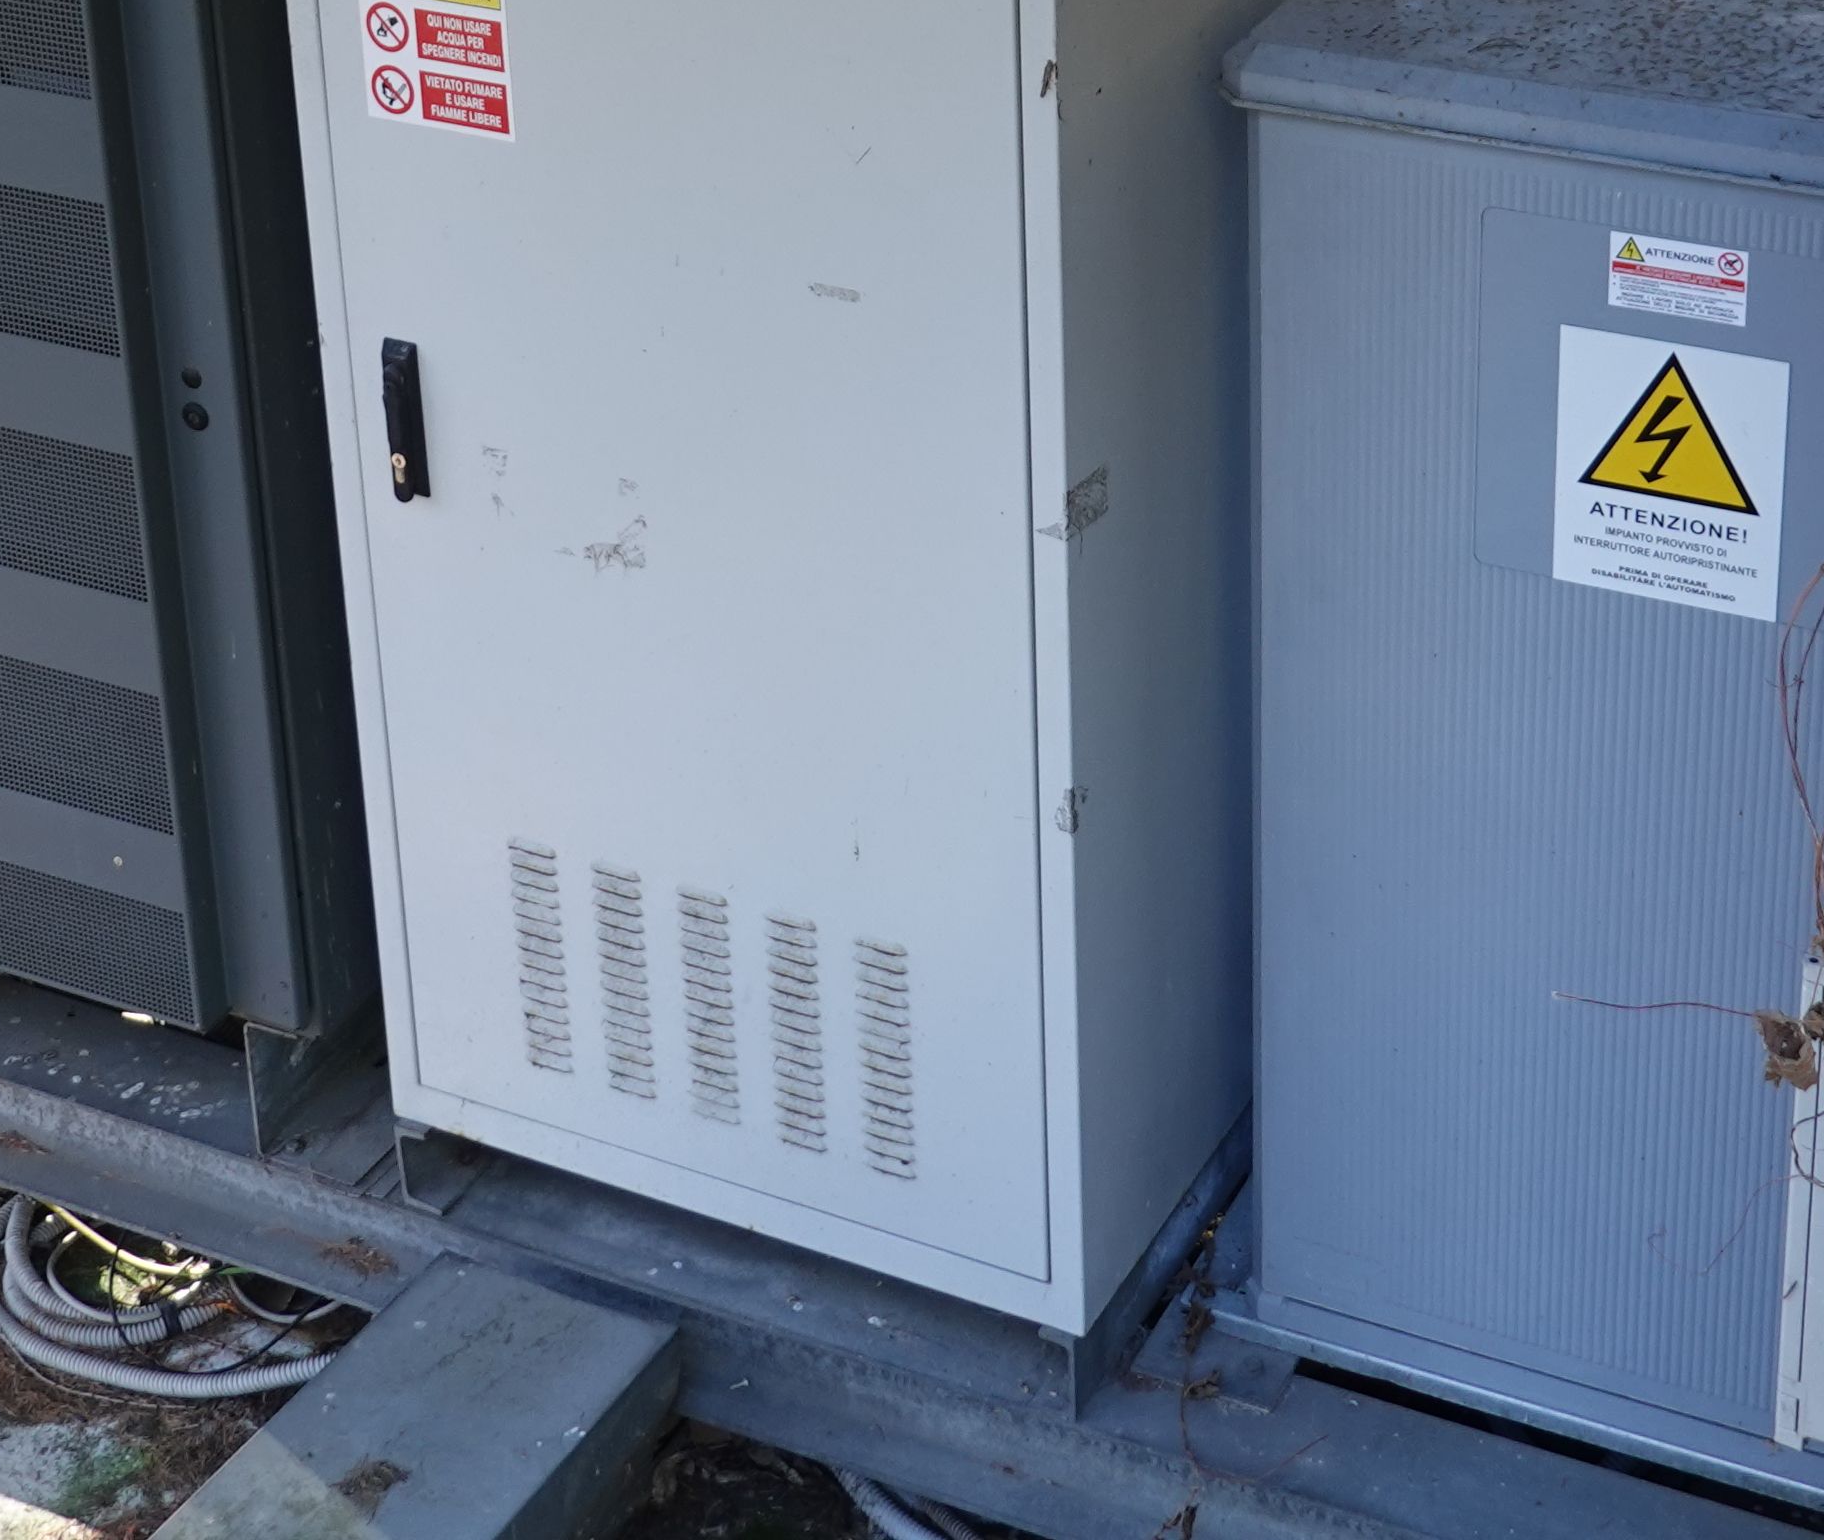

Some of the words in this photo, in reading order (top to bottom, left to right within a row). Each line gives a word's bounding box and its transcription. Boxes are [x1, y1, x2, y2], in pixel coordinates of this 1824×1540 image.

[427, 13, 443, 28] QUI
[443, 16, 462, 31] NON
[463, 19, 492, 37] USARE
[437, 30, 466, 47] ACQUA
[467, 35, 485, 50] PER
[421, 42, 466, 62] SPEGNERE
[467, 49, 502, 68] INCENDI
[425, 75, 463, 92] VIETATO
[464, 81, 504, 100] FUMARE
[445, 93, 452, 105] E
[454, 94, 486, 111] USARE
[430, 104, 468, 122] FIAMME
[469, 111, 502, 129] LIBERE
[1645, 247, 1716, 266] ATTENZIONE
[1589, 500, 1748, 544] ATTENZIONE!
[1605, 525, 1654, 544] IMPIANTO
[1656, 535, 1714, 556] PROVVISTO
[1716, 545, 1728, 558] DI
[1573, 534, 1651, 558] INTERRUTTORE
[1653, 549, 1759, 579] AUTORIPRISTINANTE
[1591, 567, 1656, 587] DISABILITARE
[1658, 580, 1737, 602] L'AUTOMATISMO
[1618, 565, 1649, 578] PRIMA
[1651, 571, 1662, 580] DI
[1664, 574, 1709, 589] OPERARE
